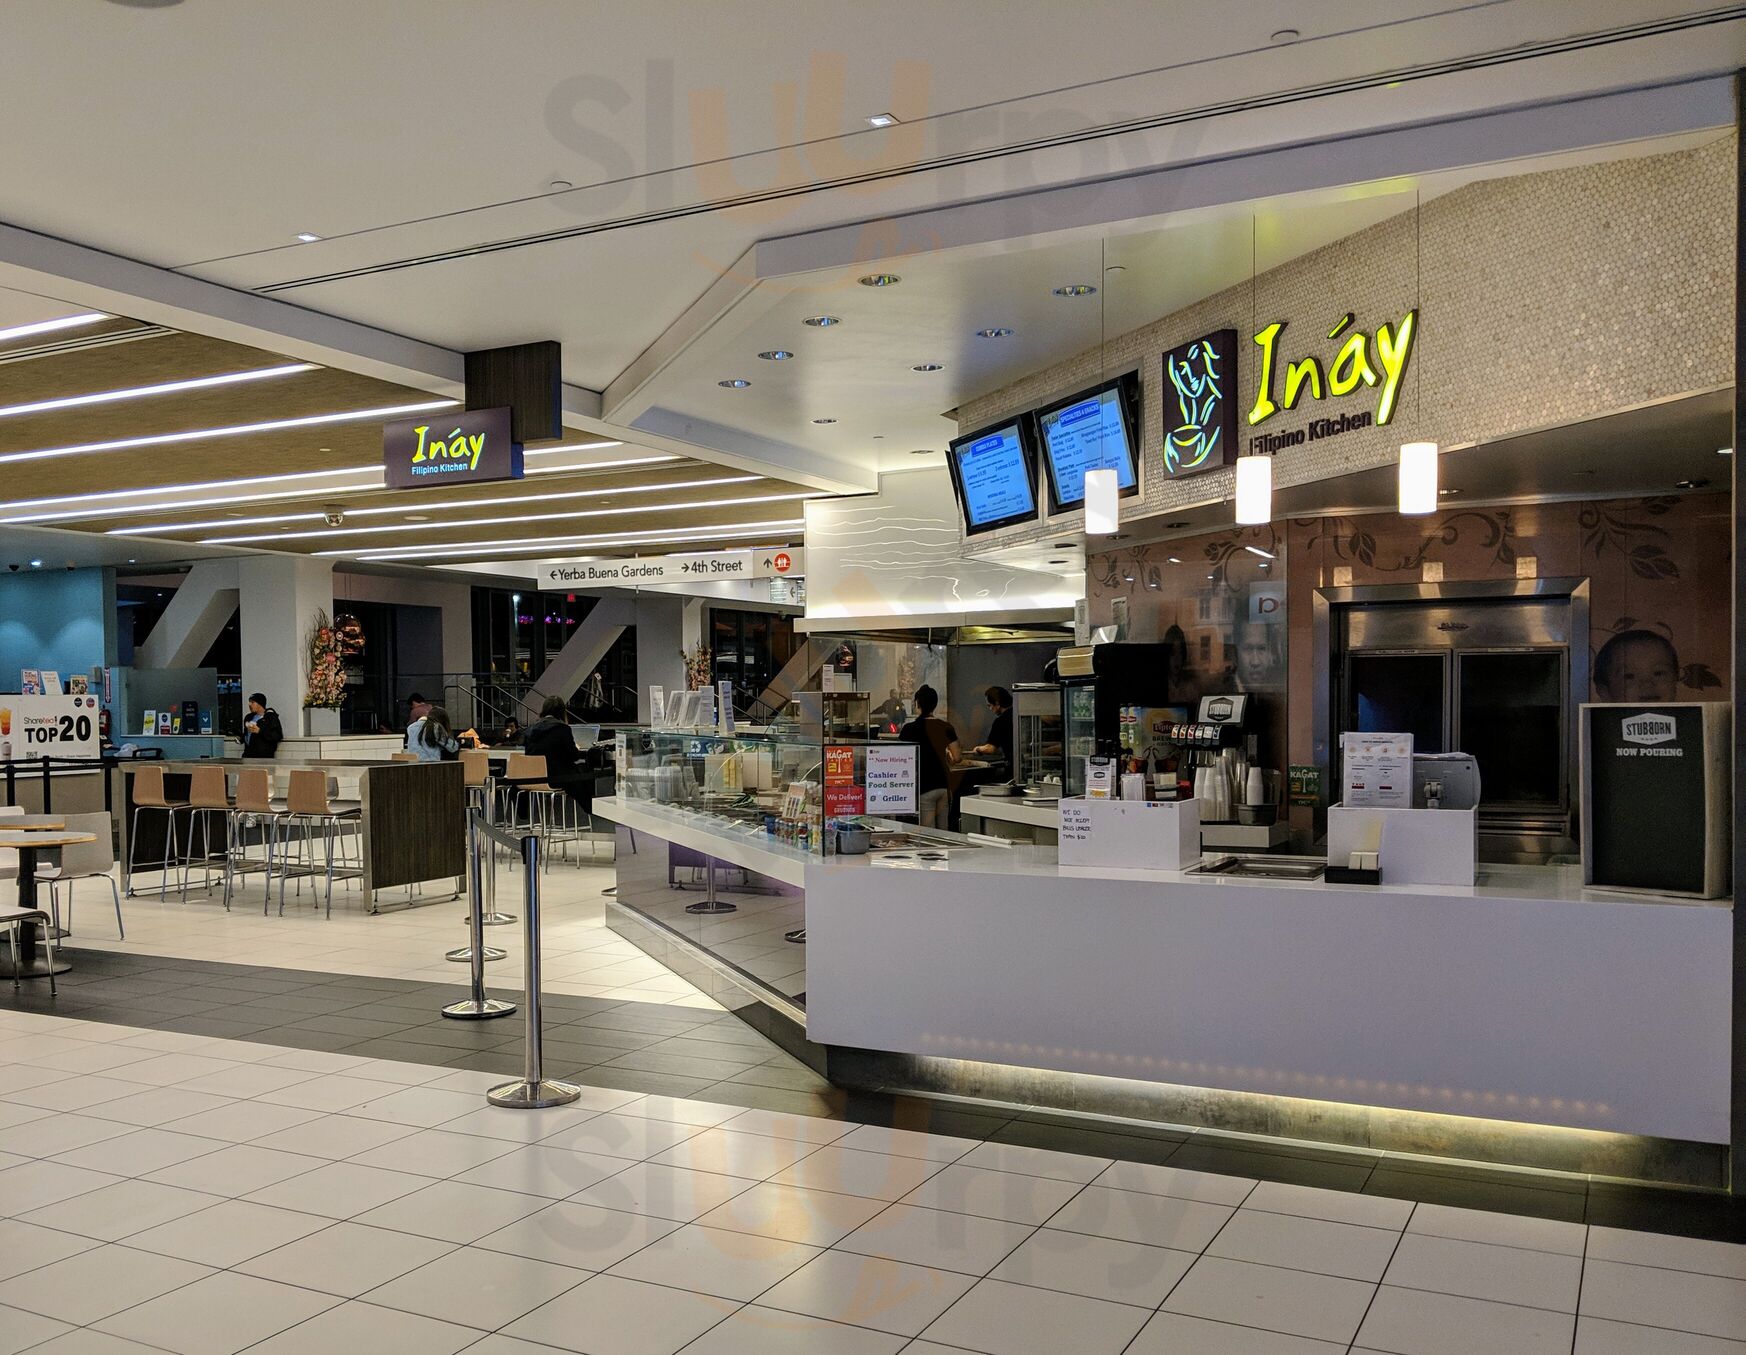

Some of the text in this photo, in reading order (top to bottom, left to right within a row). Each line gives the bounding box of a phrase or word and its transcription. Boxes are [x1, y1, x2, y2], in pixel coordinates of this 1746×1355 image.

[1248, 309, 1418, 427] Ináy
[1250, 411, 1372, 457] Filipino Kitchen
[412, 425, 485, 471] Ináy
[411, 462, 468, 476] Filipino Kitchen
[558, 563, 664, 581] Yerba Buena Gardens
[691, 559, 743, 574] 4th Street
[24, 727, 58, 743] TOP
[59, 715, 91, 741] 20
[1154, 723, 1173, 733] Lipto
[1626, 721, 1672, 736] STUBBORN
[1616, 748, 1683, 757] NOW POURING
[868, 771, 897, 779] Cashier
[1290, 769, 1319, 779] KAGAT
